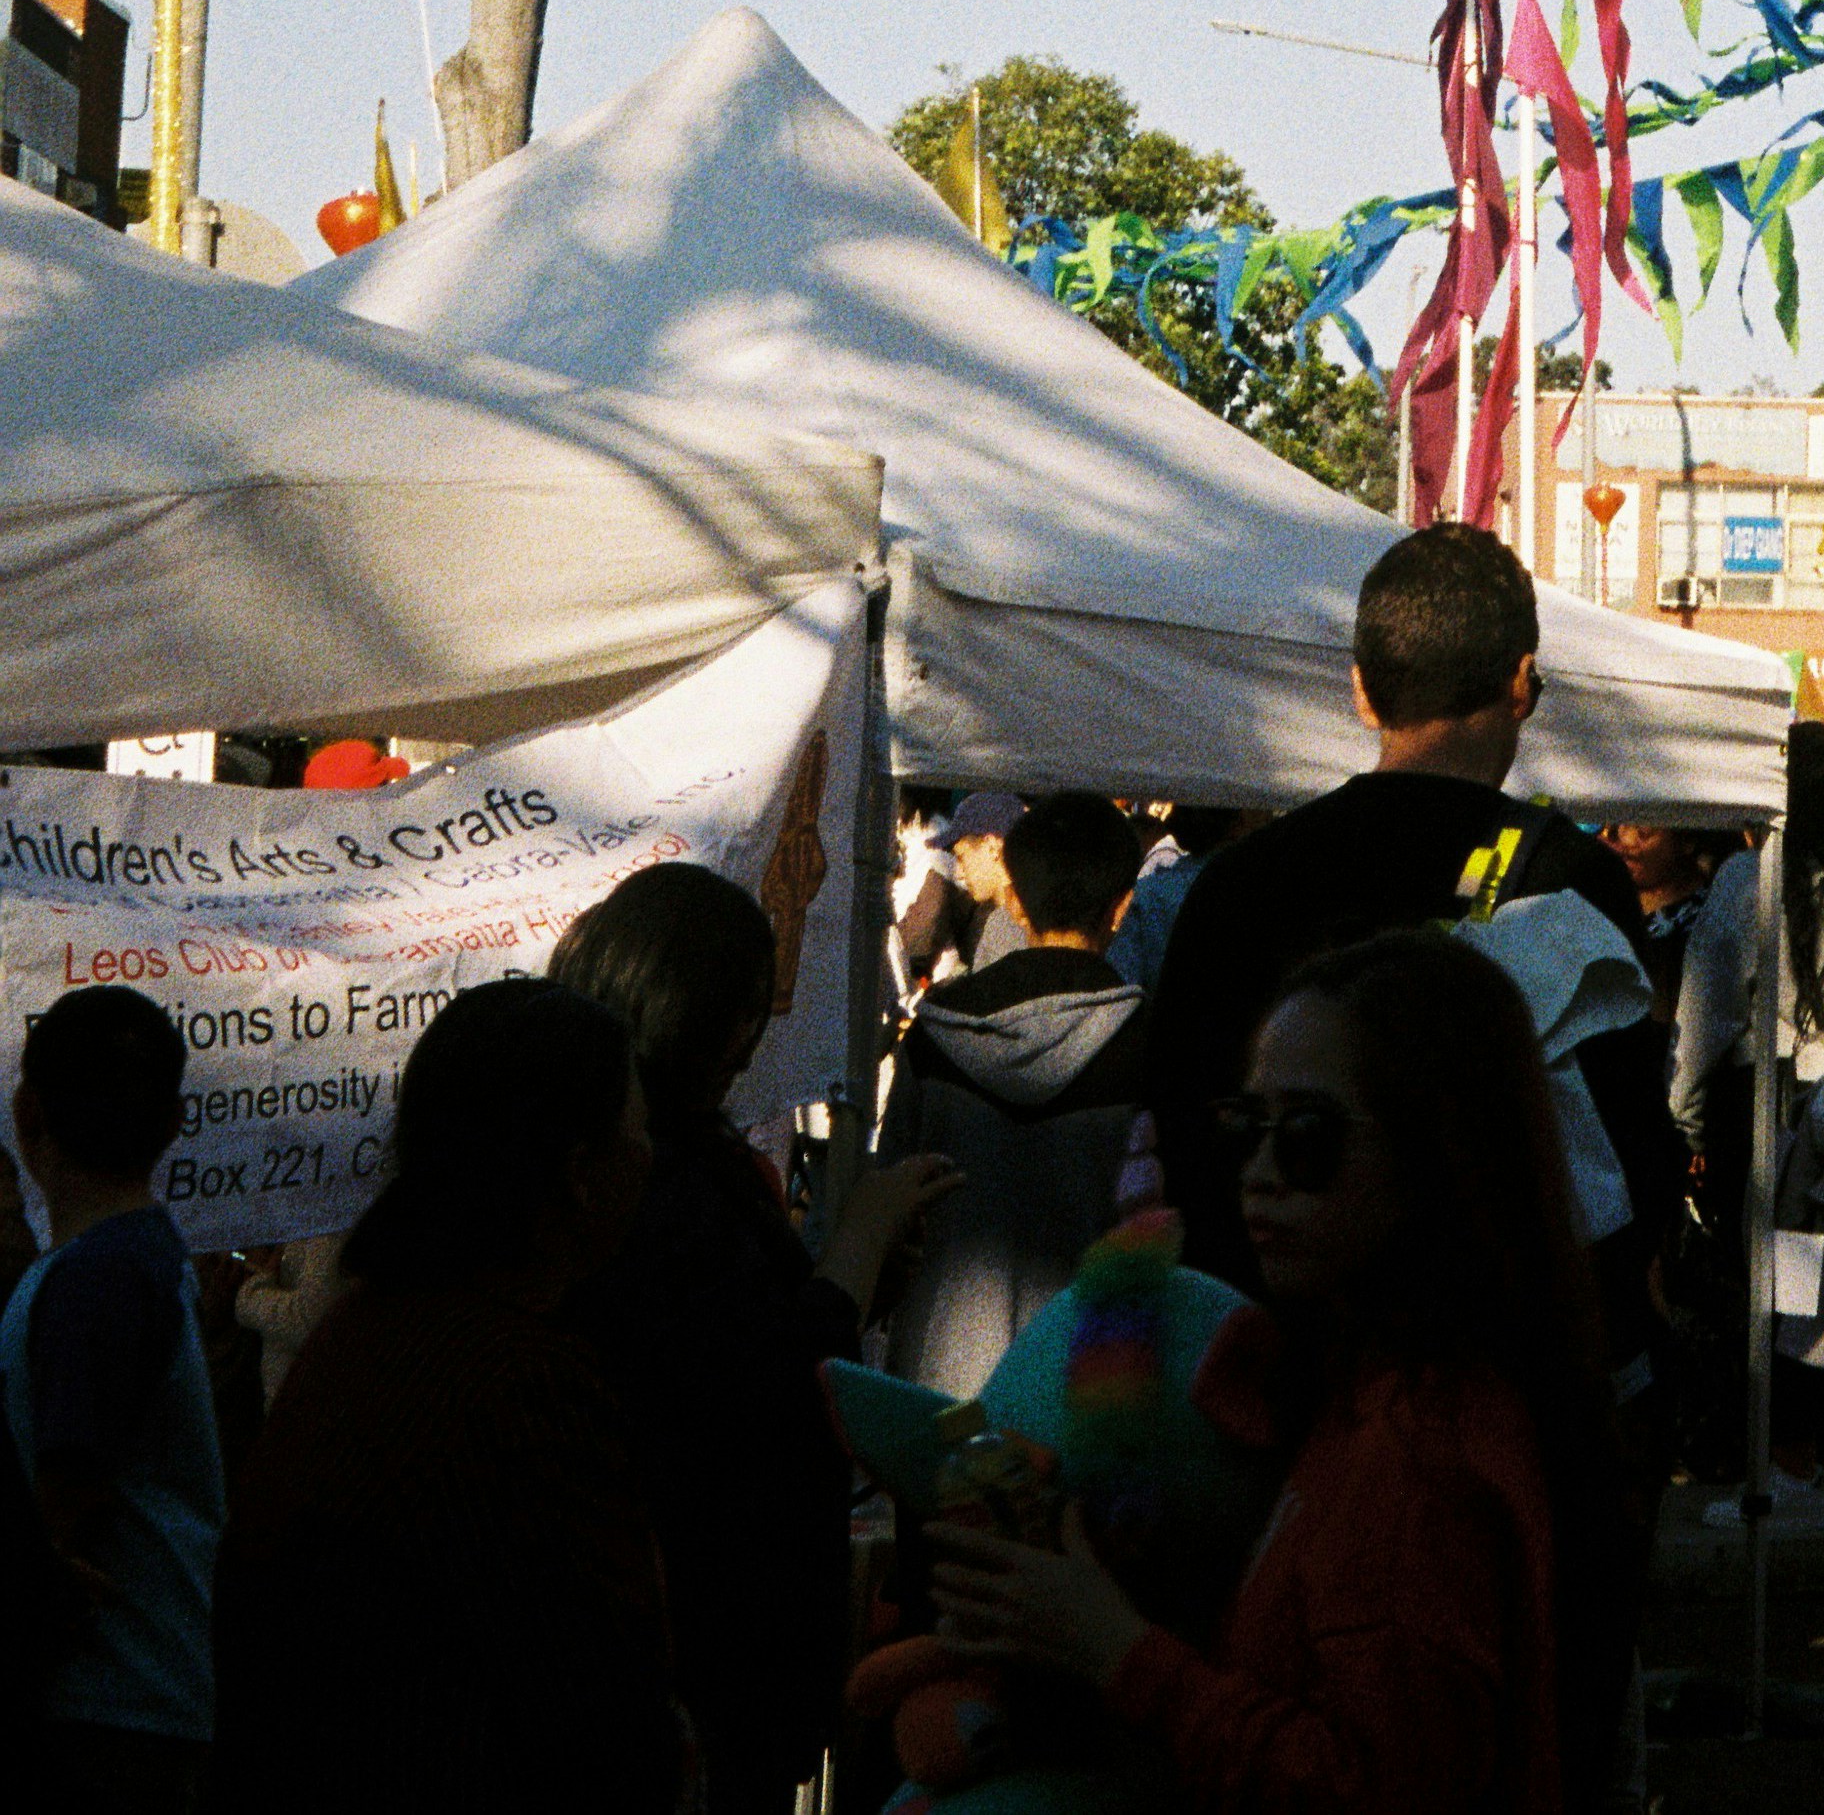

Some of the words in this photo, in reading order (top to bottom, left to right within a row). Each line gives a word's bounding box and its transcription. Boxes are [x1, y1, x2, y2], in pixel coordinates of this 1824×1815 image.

[228, 837, 337, 880] Arts
[336, 834, 394, 870] &
[388, 787, 558, 861] Crafts
[64, 942, 169, 985] Leos
[178, 937, 267, 976] Club
[290, 994, 331, 1041] to
[180, 1061, 381, 1139] generosity
[166, 1158, 248, 1202] Box
